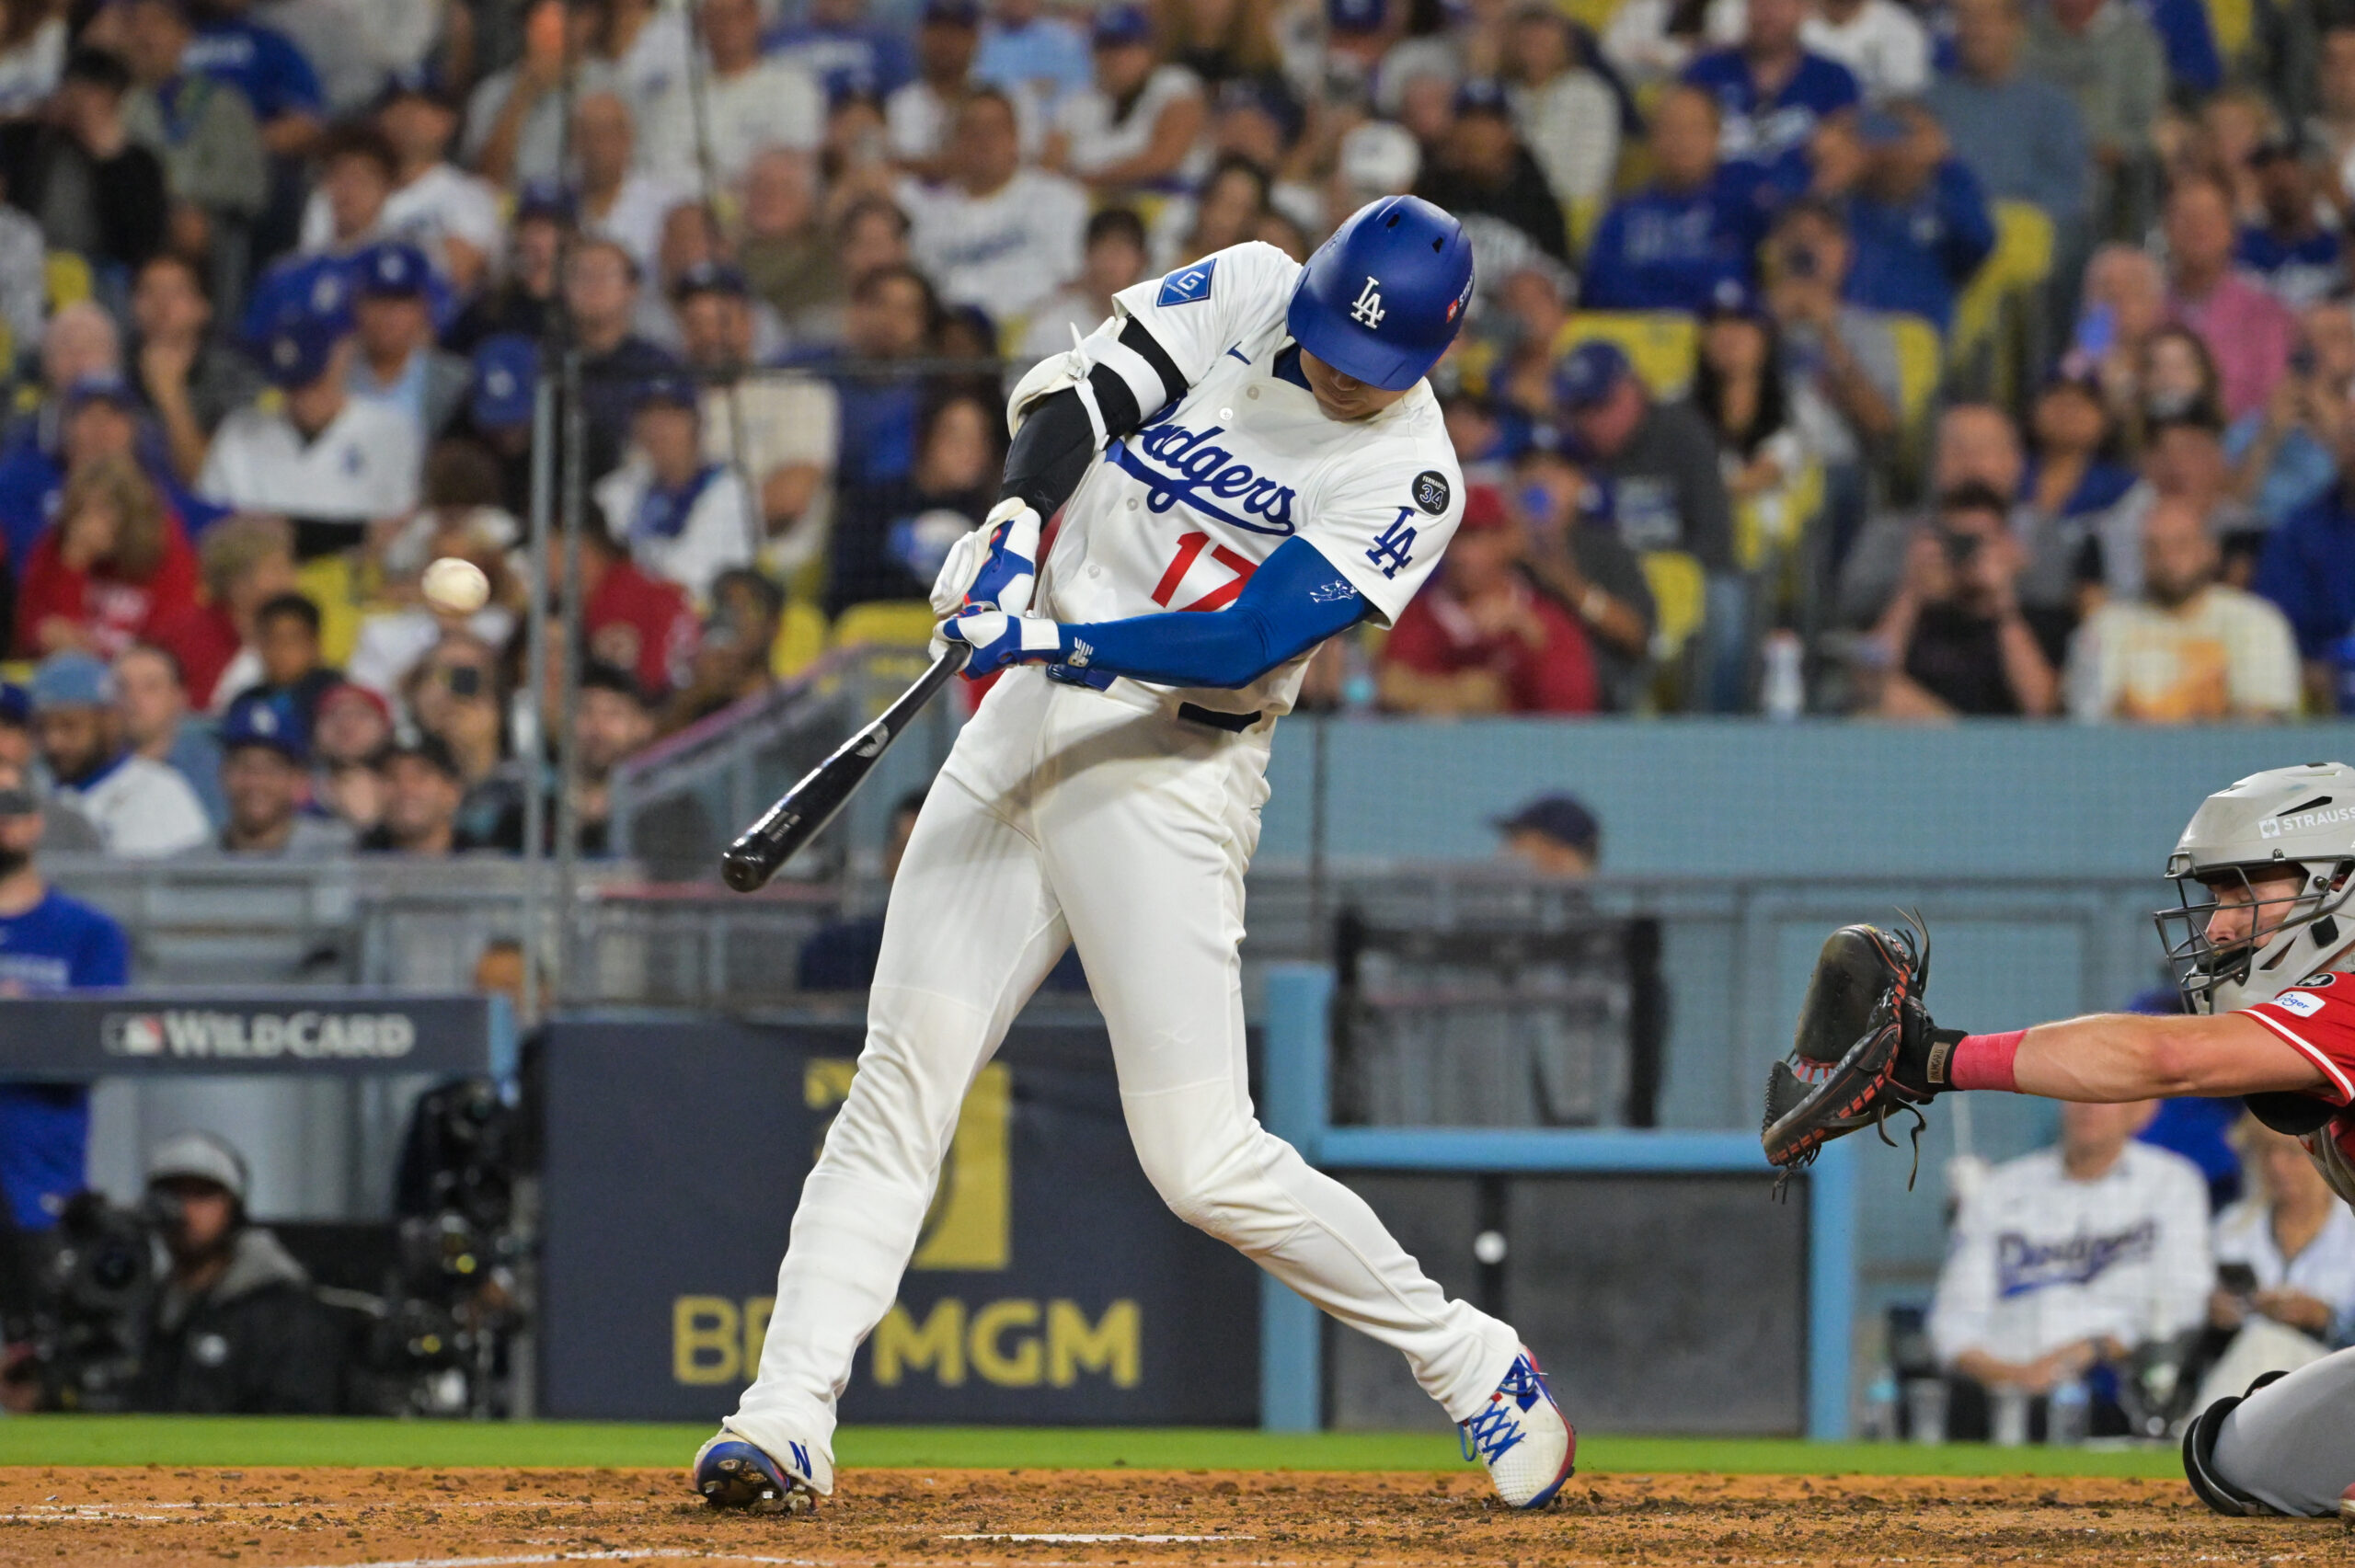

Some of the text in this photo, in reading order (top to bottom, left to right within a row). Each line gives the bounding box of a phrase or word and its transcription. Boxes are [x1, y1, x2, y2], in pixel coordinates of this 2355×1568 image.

[1178, 270, 1206, 291] G
[1350, 276, 1385, 329] LA
[1419, 484, 1443, 509] 34
[1365, 506, 1418, 580] LA
[1151, 531, 1260, 613] 17
[2282, 807, 2355, 831] STRAUSS
[673, 1296, 1143, 1389] BMGM
[788, 1440, 812, 1480] N
